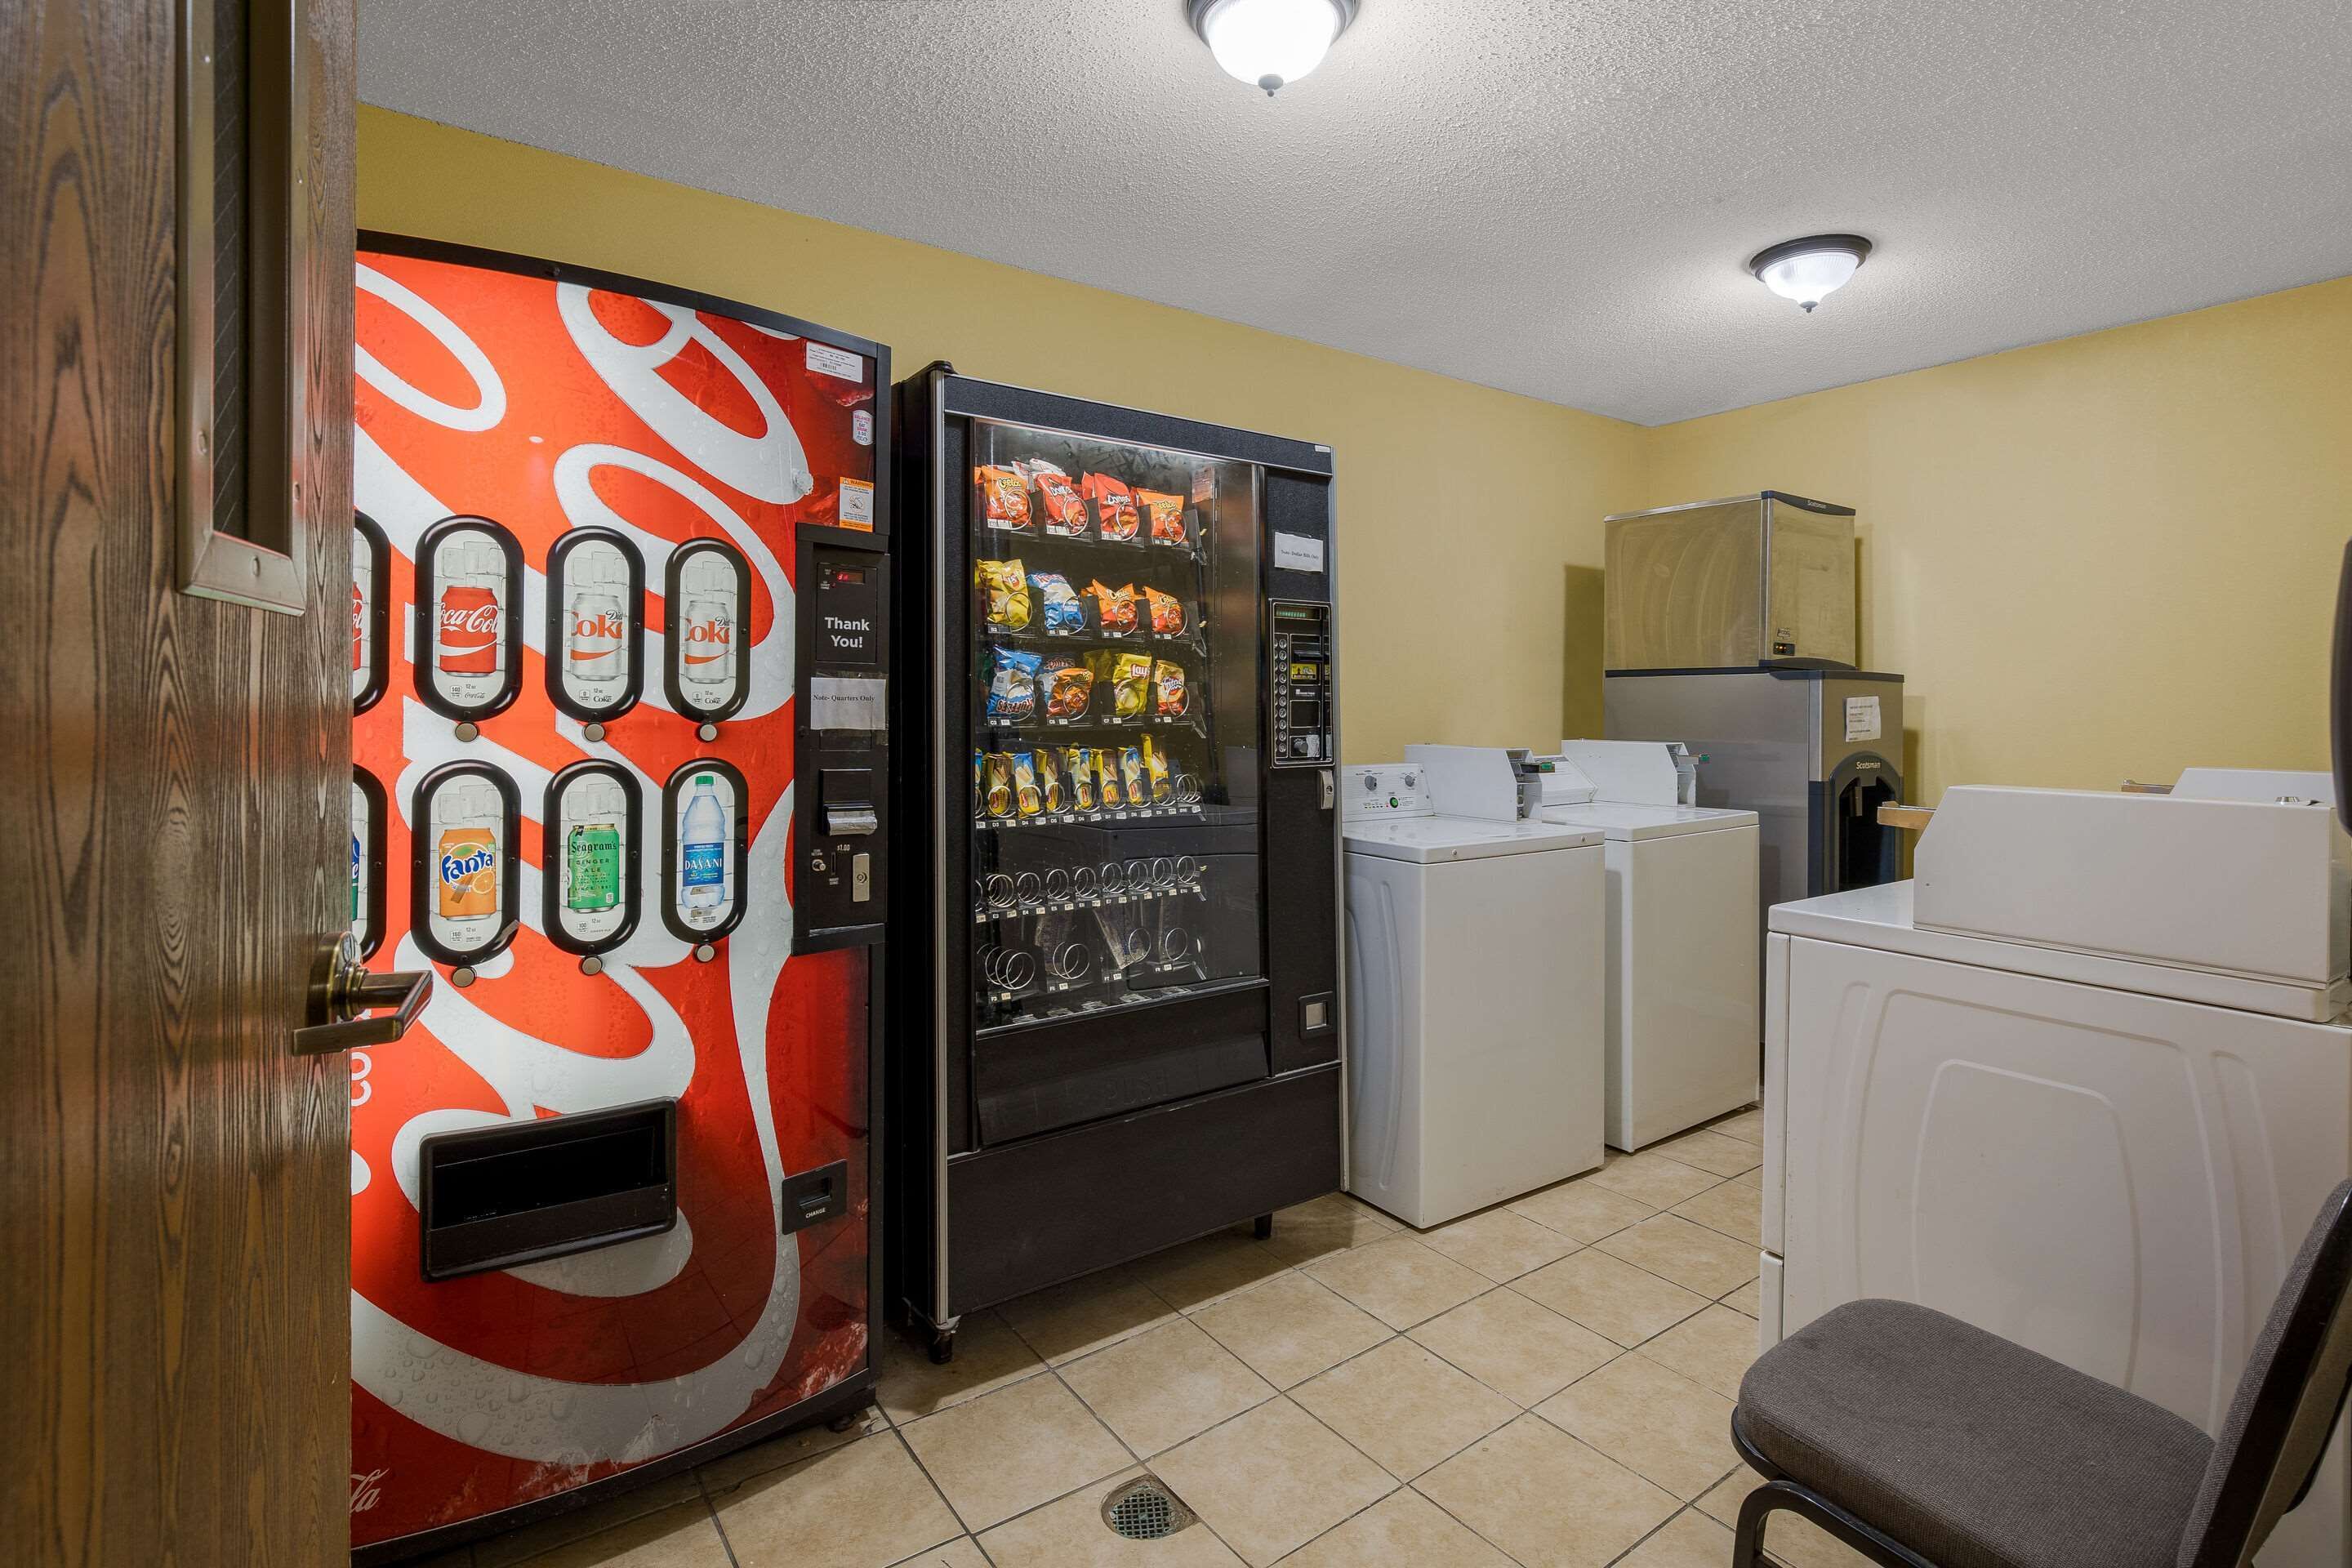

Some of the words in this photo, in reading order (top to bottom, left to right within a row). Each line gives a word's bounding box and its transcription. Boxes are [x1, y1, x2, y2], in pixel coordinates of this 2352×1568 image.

[1107, 493, 1131, 504] Doritos
[824, 617, 870, 631] Thank
[831, 635, 863, 648] You!
[1856, 760, 1881, 770] Scotsman
[571, 840, 617, 853] Seagram's
[685, 856, 723, 871] DASANI
[805, 1207, 826, 1218] CHANGE
